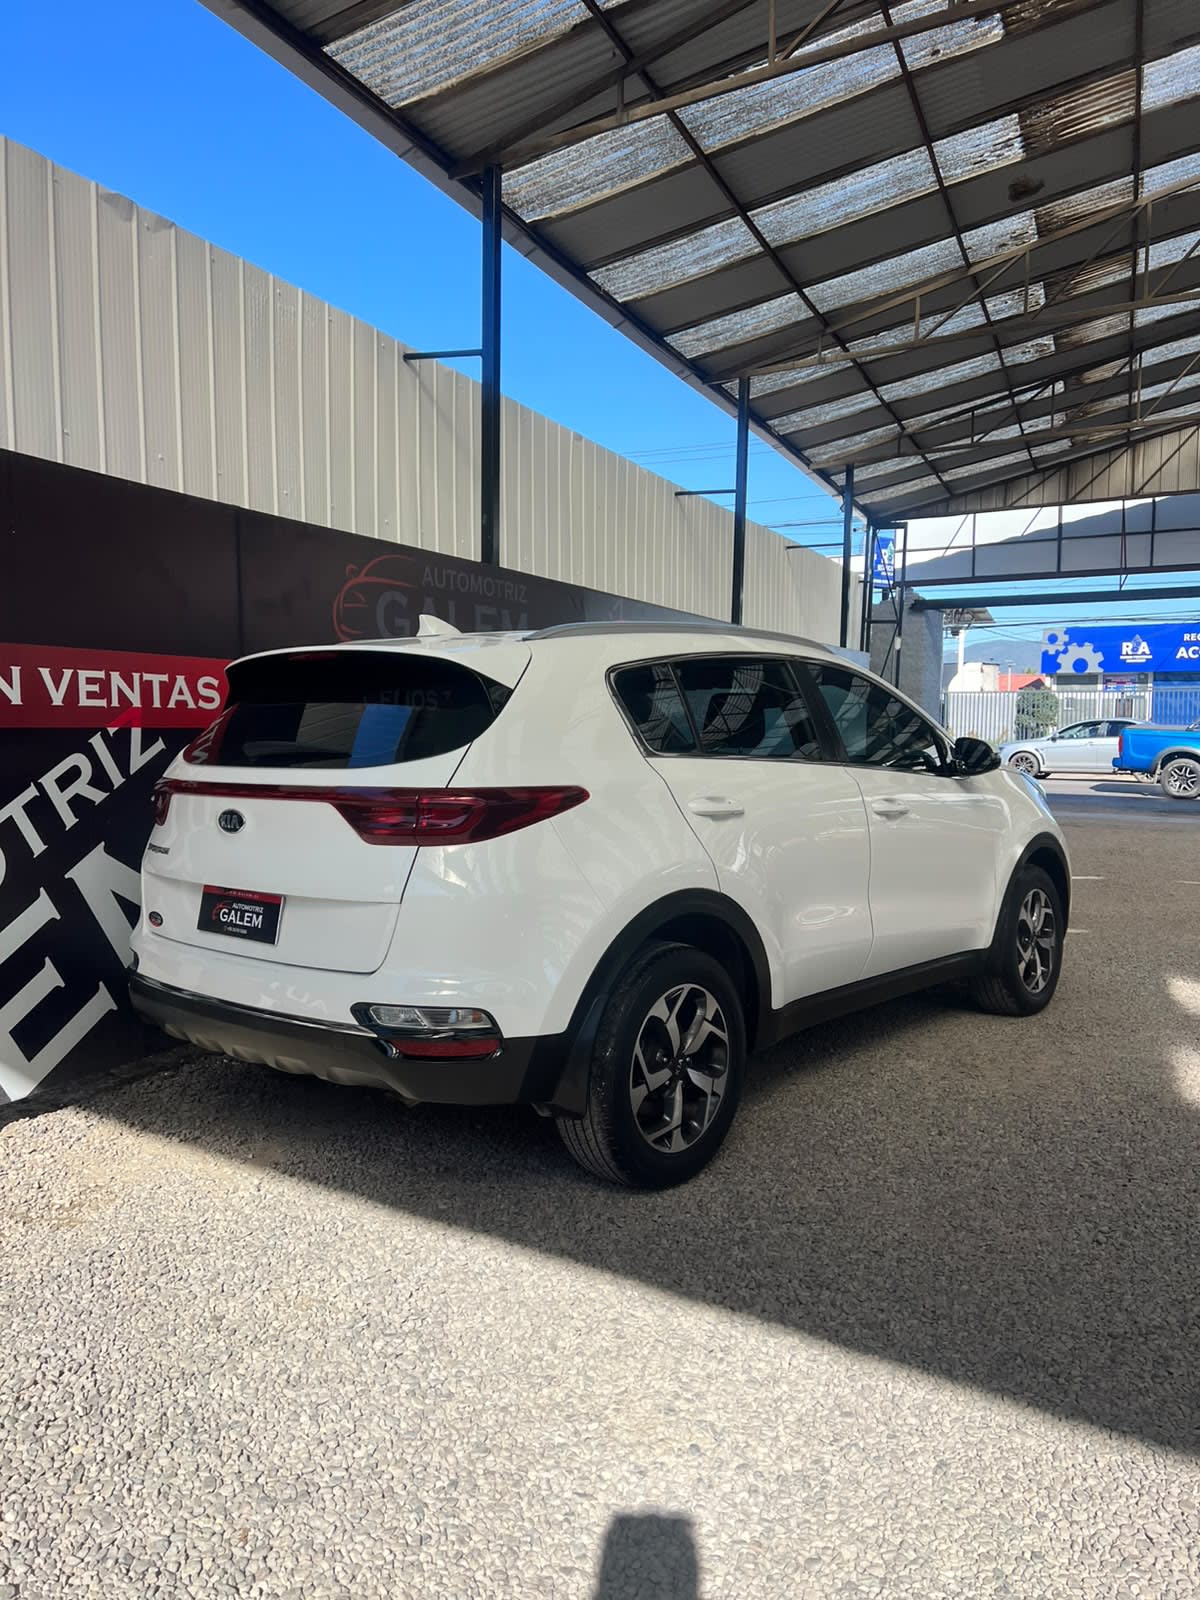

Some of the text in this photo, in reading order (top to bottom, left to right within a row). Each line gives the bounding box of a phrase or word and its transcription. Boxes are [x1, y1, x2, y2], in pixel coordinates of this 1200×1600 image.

[422, 565, 527, 603] AUTOMOTRIZ
[1183, 632, 1200, 641] RE
[1175, 646, 1200, 659] AC
[37, 667, 221, 710] VENTAS
[0, 707, 166, 886] TRIZ
[221, 814, 241, 829] KIA
[232, 902, 264, 914] AUTOMOTRIZ
[220, 908, 263, 928] GALEM
